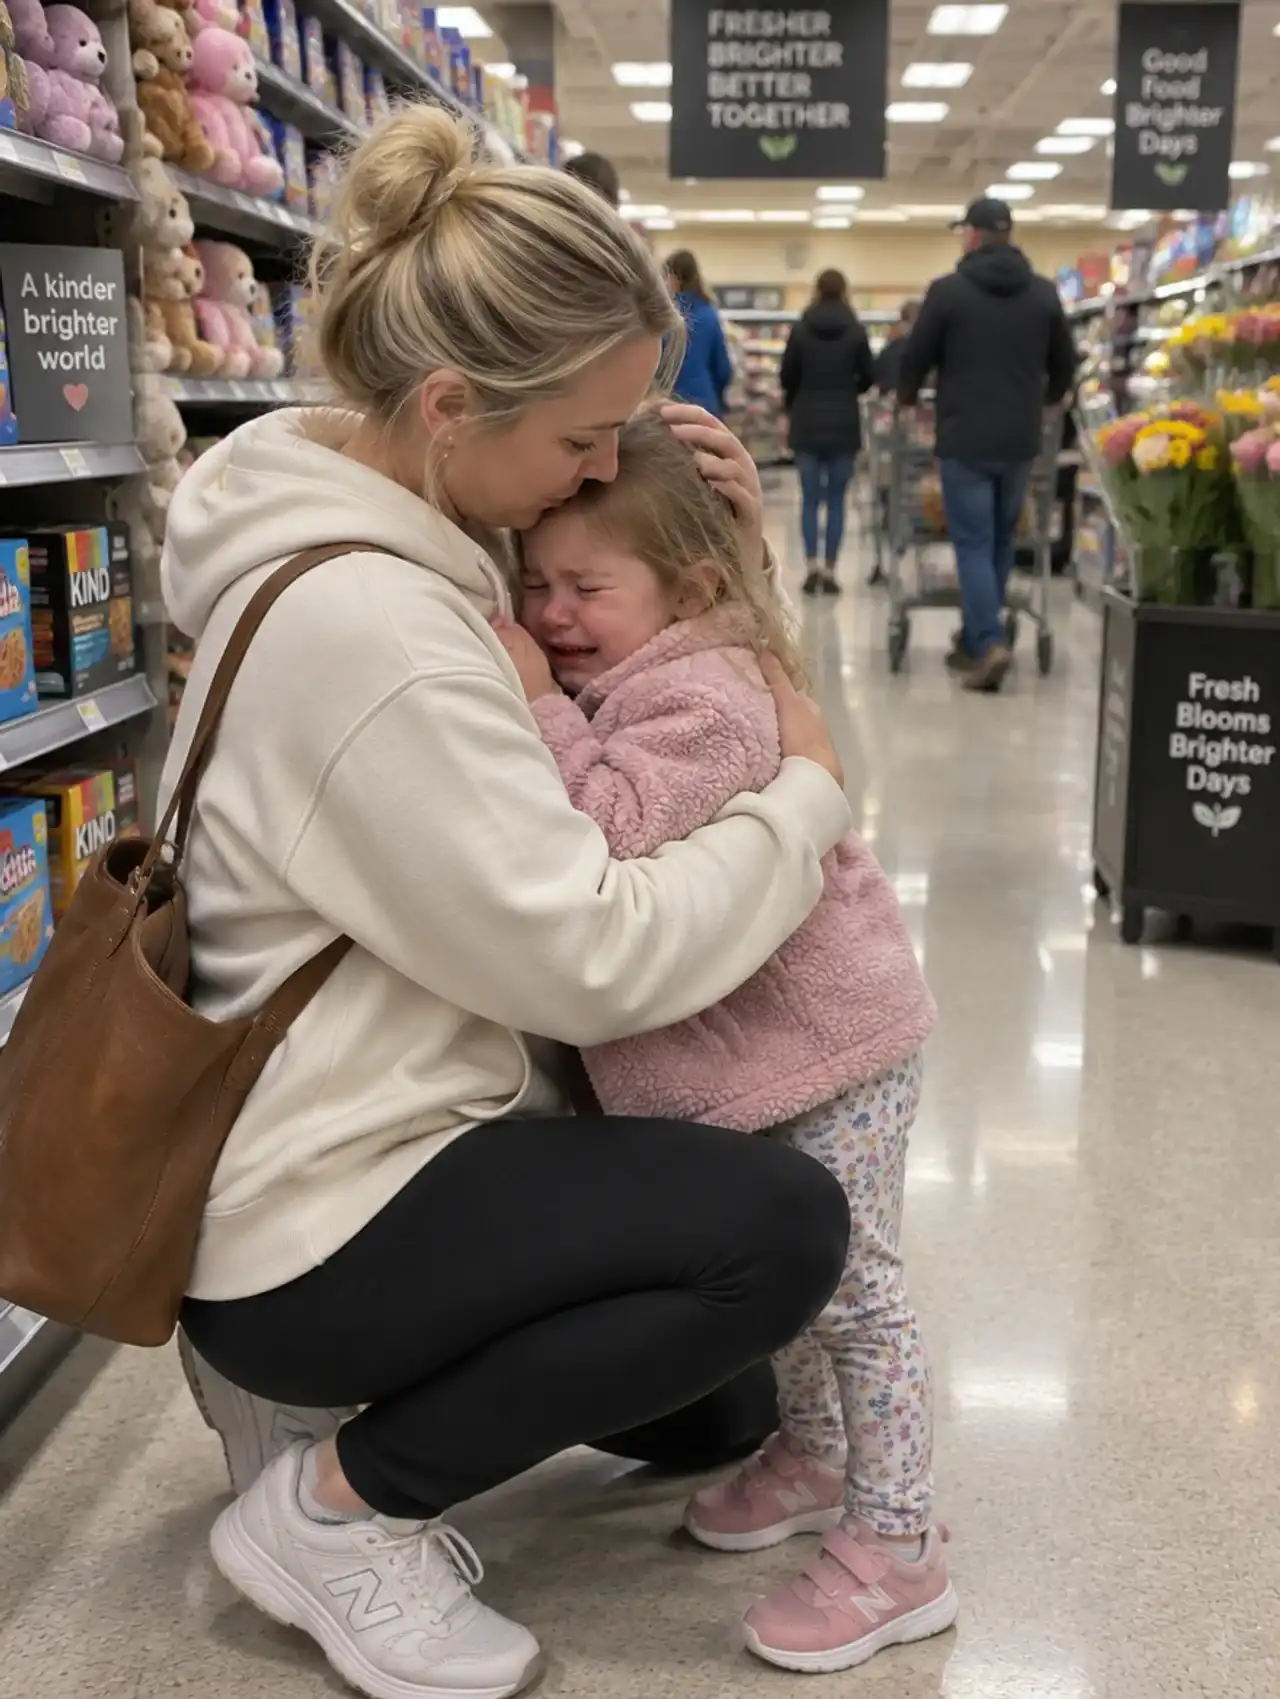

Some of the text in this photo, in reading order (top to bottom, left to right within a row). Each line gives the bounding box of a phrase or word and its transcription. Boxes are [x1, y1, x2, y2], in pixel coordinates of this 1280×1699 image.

[708, 9, 832, 36] FRESHER
[707, 41, 844, 68] BRIGHTER
[1142, 47, 1209, 74] Good
[707, 71, 812, 98] BETTER
[1141, 74, 1202, 100] Food
[706, 102, 851, 129] TOGETHER
[1125, 101, 1224, 133] Brighter
[1138, 129, 1199, 161] Days
[21, 272, 117, 300] A kinder
[23, 308, 119, 341] brighter
[37, 344, 106, 370] world
[69, 567, 110, 607] KIND
[1188, 671, 1260, 703] Fresh
[1176, 701, 1271, 735] Blooms
[1169, 732, 1276, 768] Brighter
[1186, 764, 1252, 799] Days
